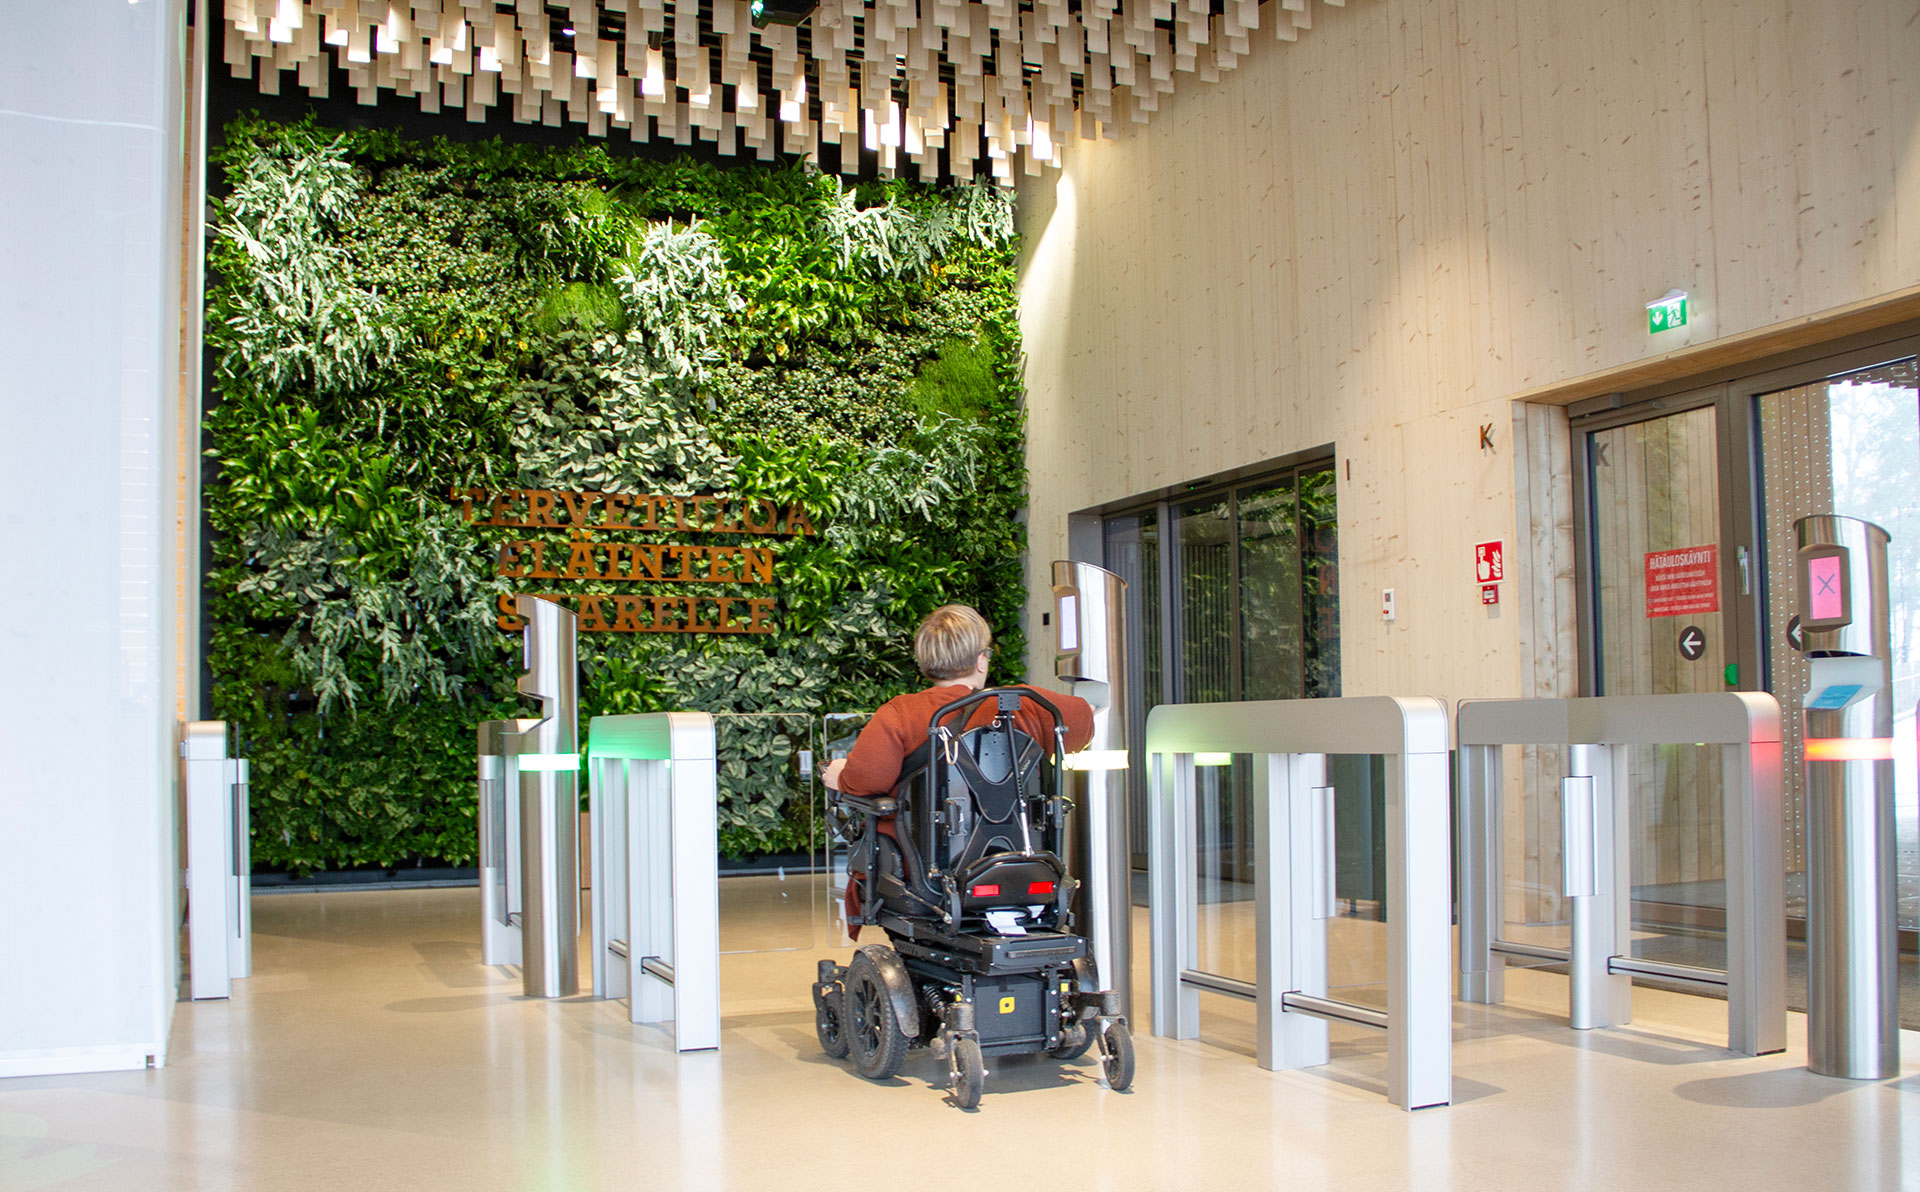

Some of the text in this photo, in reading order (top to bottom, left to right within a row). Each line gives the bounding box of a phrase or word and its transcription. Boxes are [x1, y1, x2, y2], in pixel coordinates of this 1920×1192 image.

[1480, 422, 1494, 450] K
[498, 530, 775, 584] ELÄINTEN
[498, 593, 775, 634] SARELLE
